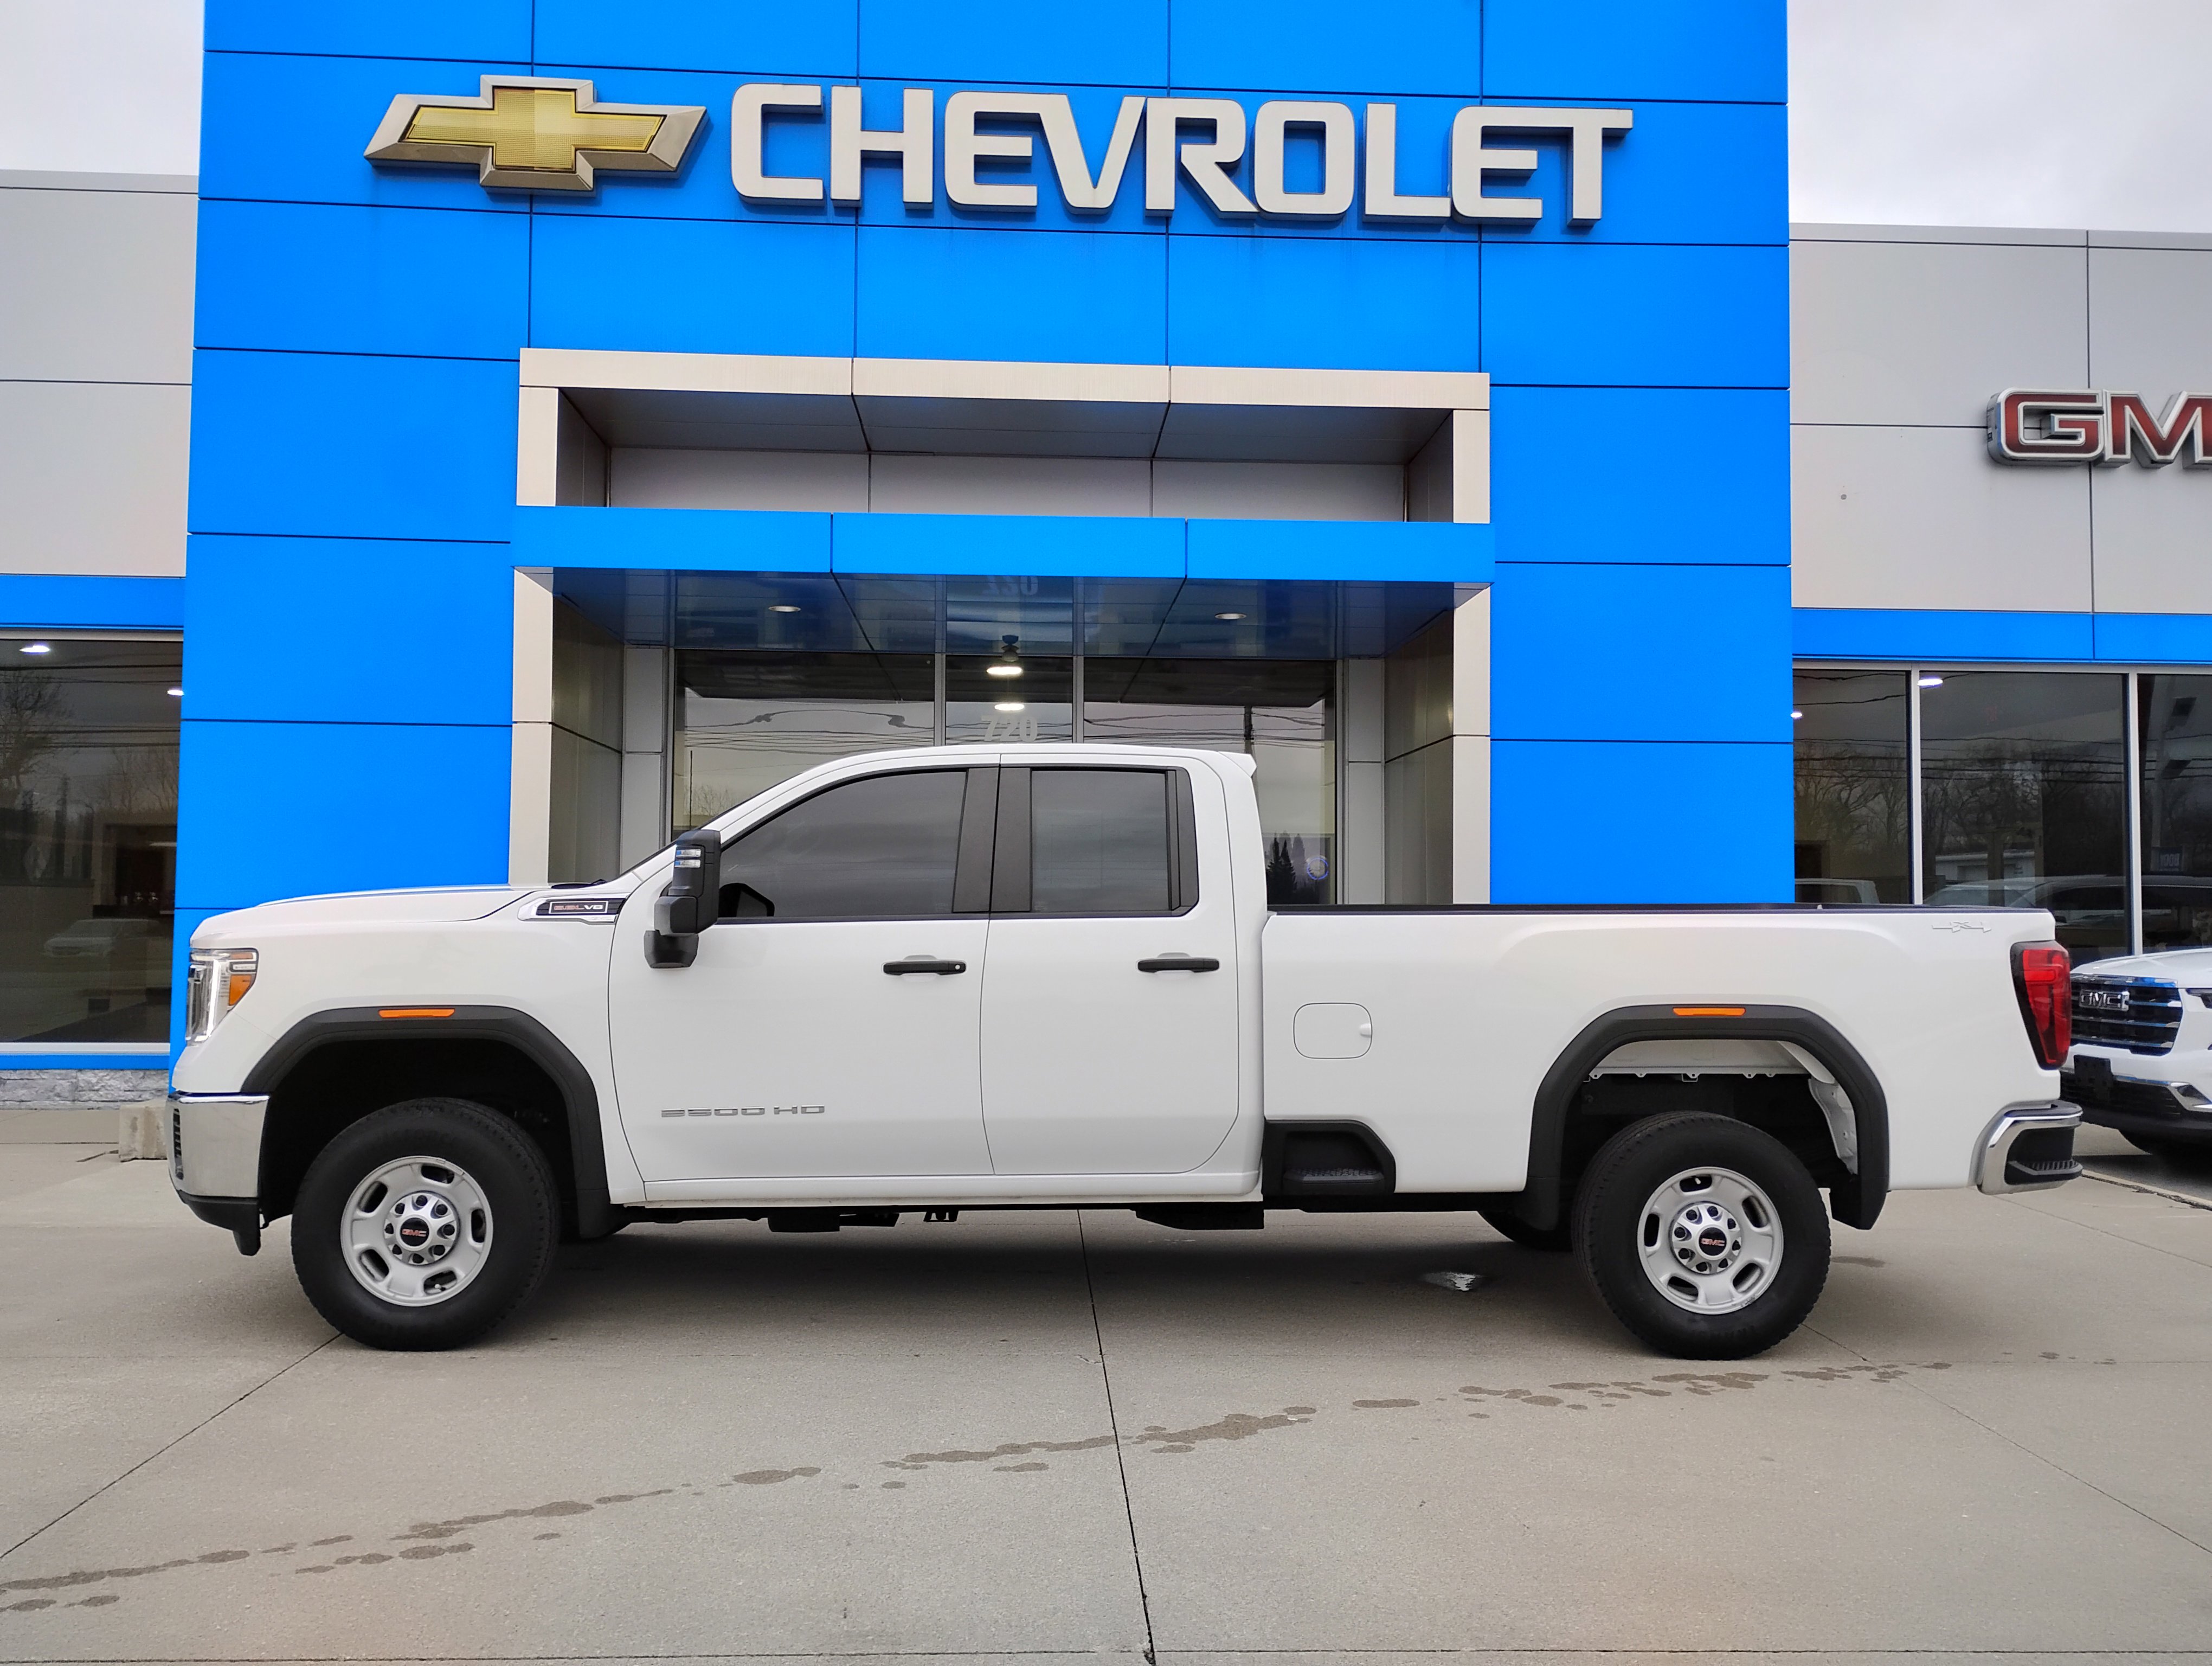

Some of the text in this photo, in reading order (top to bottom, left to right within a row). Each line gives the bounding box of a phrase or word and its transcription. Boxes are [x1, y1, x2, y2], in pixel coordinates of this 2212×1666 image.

[730, 83, 1634, 227] CHEVROLET
[981, 715, 1038, 742] 720
[2080, 990, 2126, 1010] GMC
[661, 1105, 825, 1118] 2500 HD
[402, 1228, 427, 1237] GMC
[1701, 1238, 1725, 1246] GMC
